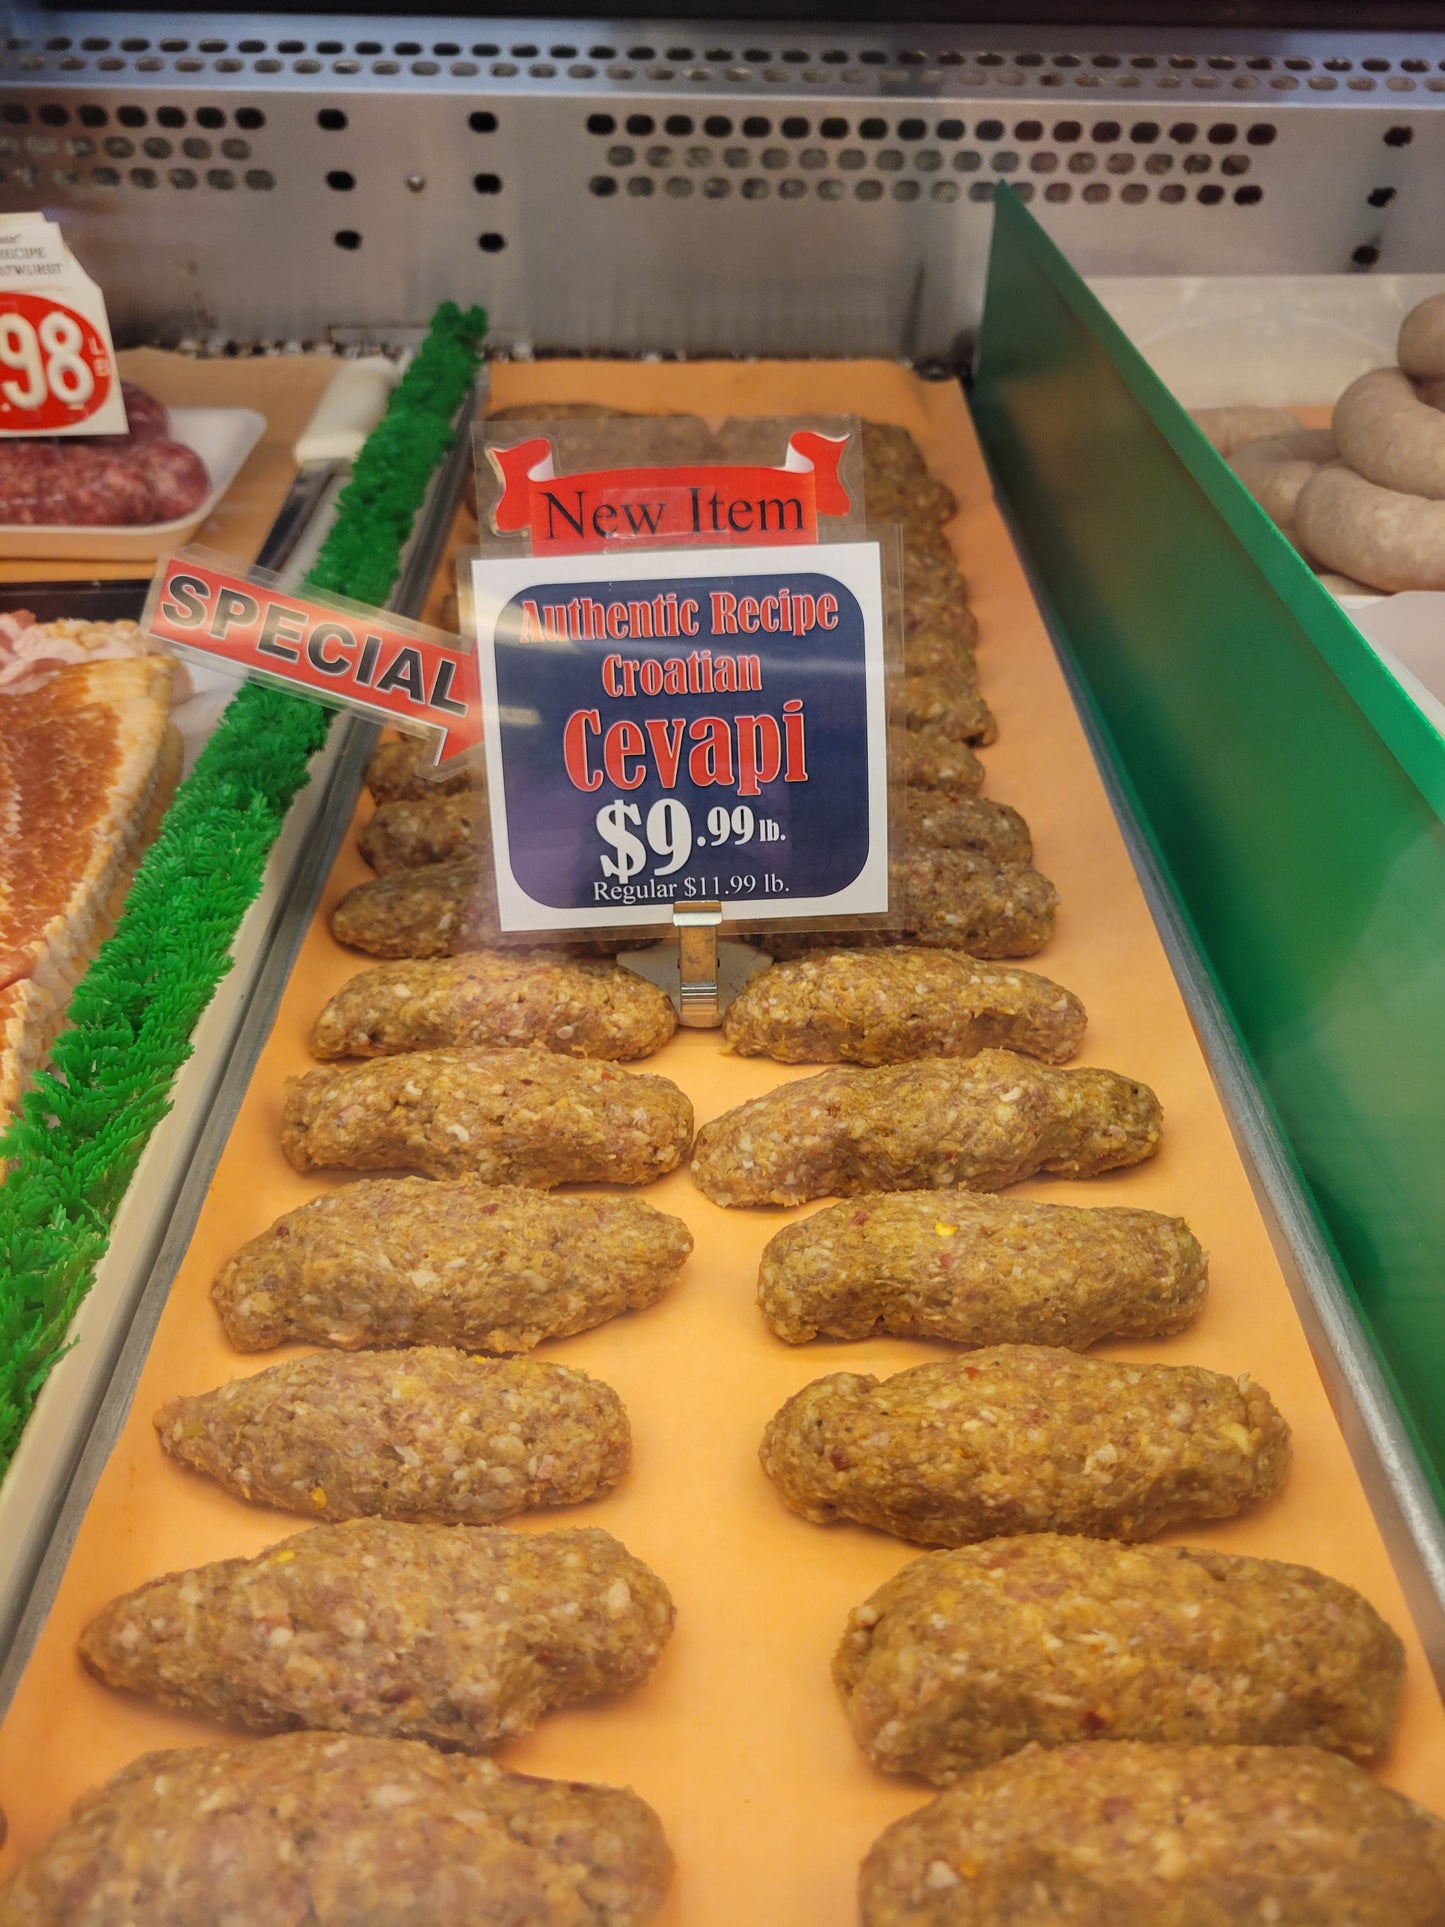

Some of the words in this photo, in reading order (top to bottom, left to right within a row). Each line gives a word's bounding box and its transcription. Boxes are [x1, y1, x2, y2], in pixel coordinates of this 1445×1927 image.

[538, 489, 668, 541] New
[689, 486, 806, 534] Item
[519, 593, 700, 645] Authentic
[710, 588, 840, 637] Recipe
[161, 573, 469, 719] SPECIAL
[601, 649, 763, 698] Croatian
[563, 699, 809, 797] Cevapi
[758, 819, 786, 842] lb.
[593, 879, 678, 904] Regular
[684, 873, 757, 898] $11.99
[764, 873, 790, 893] lb.
